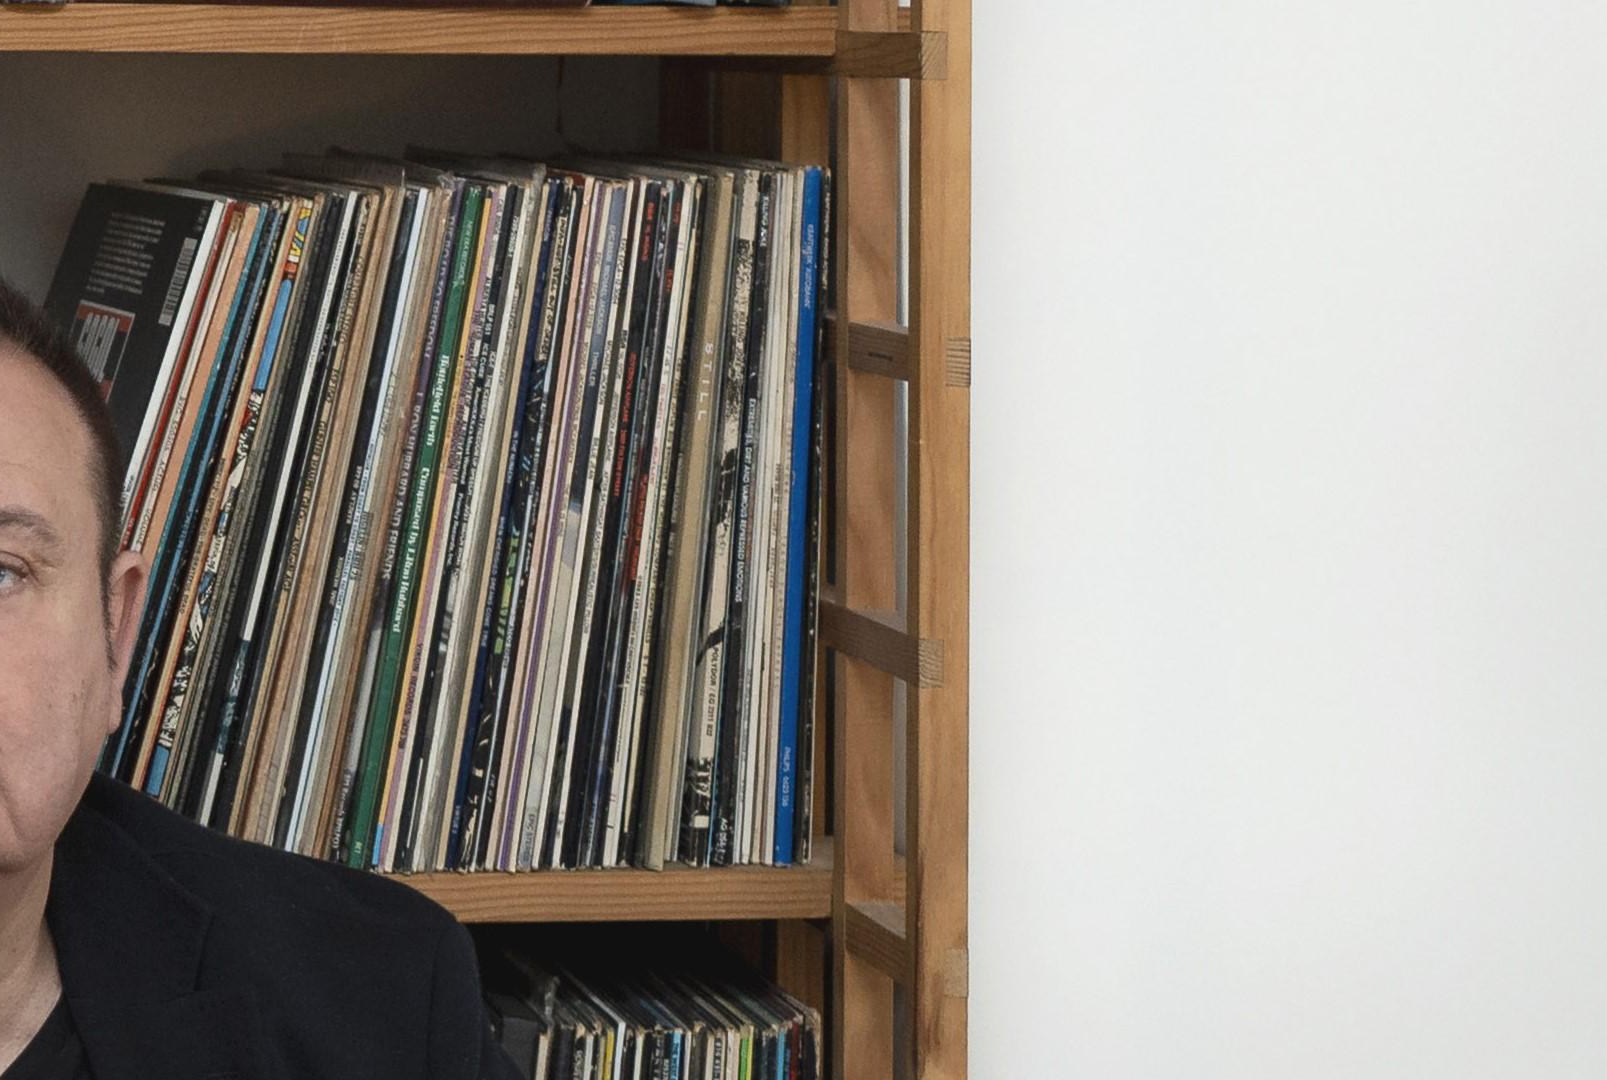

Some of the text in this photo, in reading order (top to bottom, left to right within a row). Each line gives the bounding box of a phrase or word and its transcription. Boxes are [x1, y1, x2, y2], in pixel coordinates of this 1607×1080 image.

[760, 195, 769, 225] KILLING
[588, 264, 611, 386] MICHAEL JACKSON THRILLER
[601, 339, 612, 372] MICHAEL
[597, 373, 608, 405] JACKSON
[697, 342, 714, 421] STILL
[587, 460, 596, 480] JEAN
[743, 446, 752, 464] DIRT
[381, 404, 421, 580] RON AND FRIENDS
[741, 465, 751, 483] AND
[739, 484, 749, 517] VARIOUS
[390, 414, 439, 633] Earth Composed by Hubbard
[736, 519, 746, 559] REPRESSED
[734, 560, 744, 602] EMOTIONS
[403, 674, 417, 715] RECORDS
